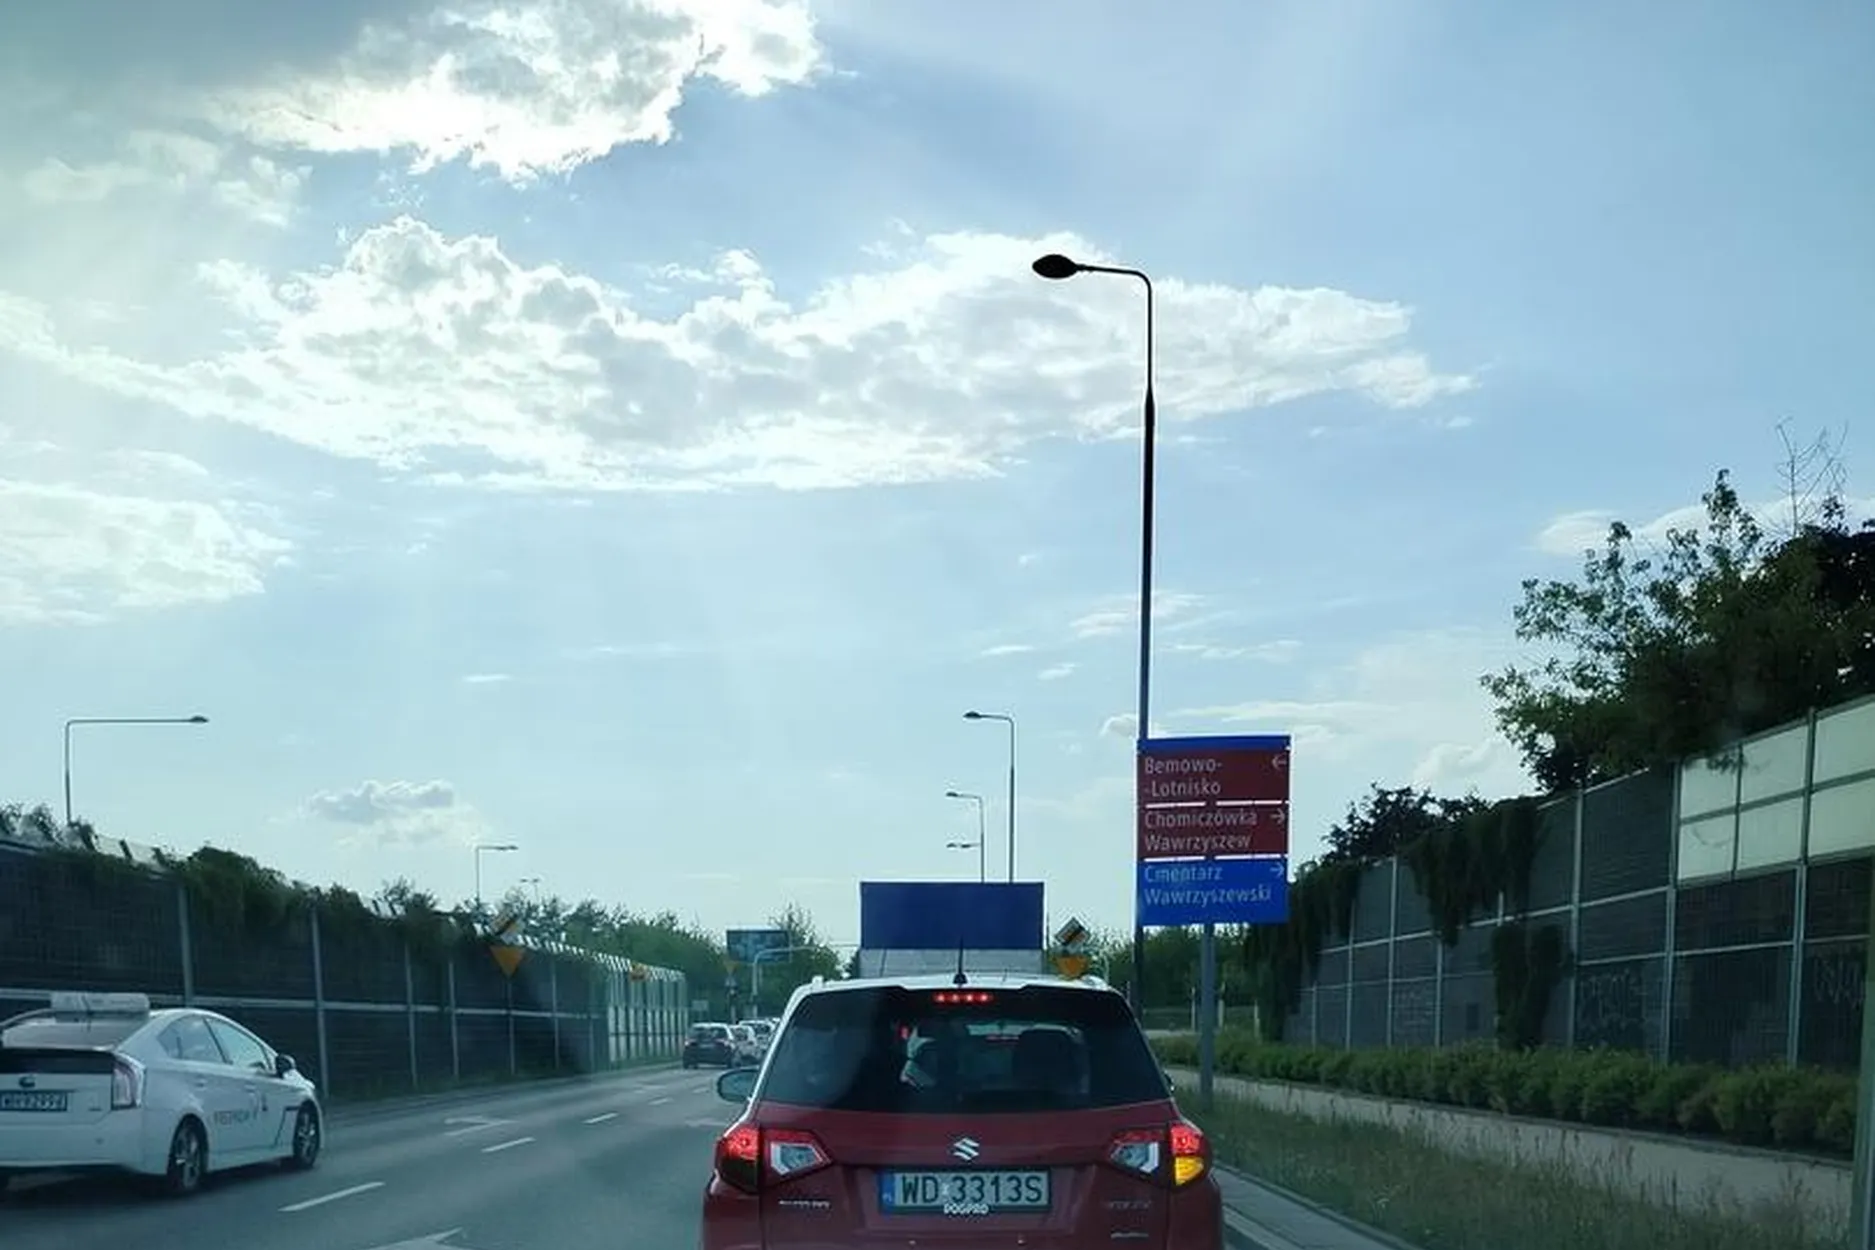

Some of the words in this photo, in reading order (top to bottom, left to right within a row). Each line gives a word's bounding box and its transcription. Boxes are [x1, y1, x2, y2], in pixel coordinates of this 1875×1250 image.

[1144, 756, 1223, 774] Bemowo-
[1144, 777, 1221, 797] -Lotnisko
[1144, 808, 1258, 829] Chomiczówka
[1144, 833, 1250, 853] Wawrzyszew
[1144, 866, 1223, 883] Cmentarz
[1144, 884, 1271, 908] Wawrzyszewski
[902, 1176, 939, 1203] WD
[951, 1175, 1043, 1203] 3313S
